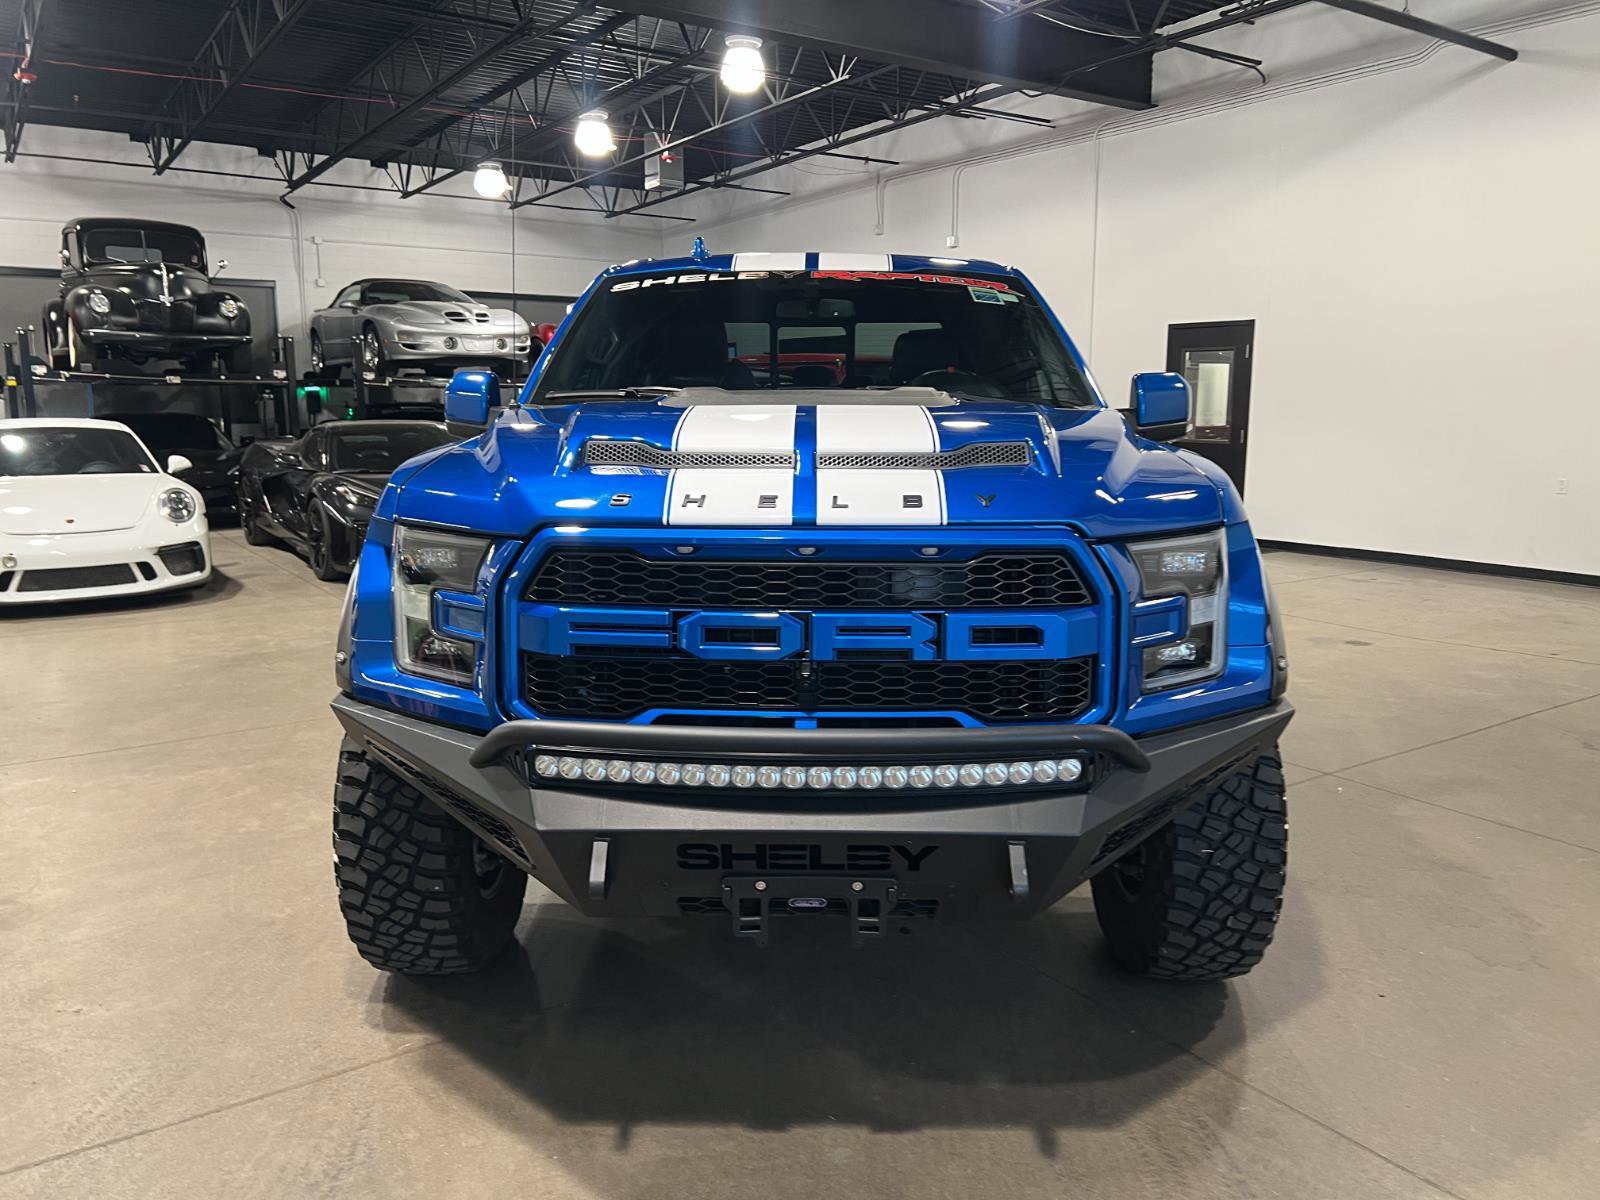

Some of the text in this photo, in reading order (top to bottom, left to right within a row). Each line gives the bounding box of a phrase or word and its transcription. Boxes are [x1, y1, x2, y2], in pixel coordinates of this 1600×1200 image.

[610, 270, 806, 292] SHELBY
[811, 271, 1024, 297] RAPTOR
[545, 606, 1074, 661] FORD
[676, 843, 939, 871] SHELBY
